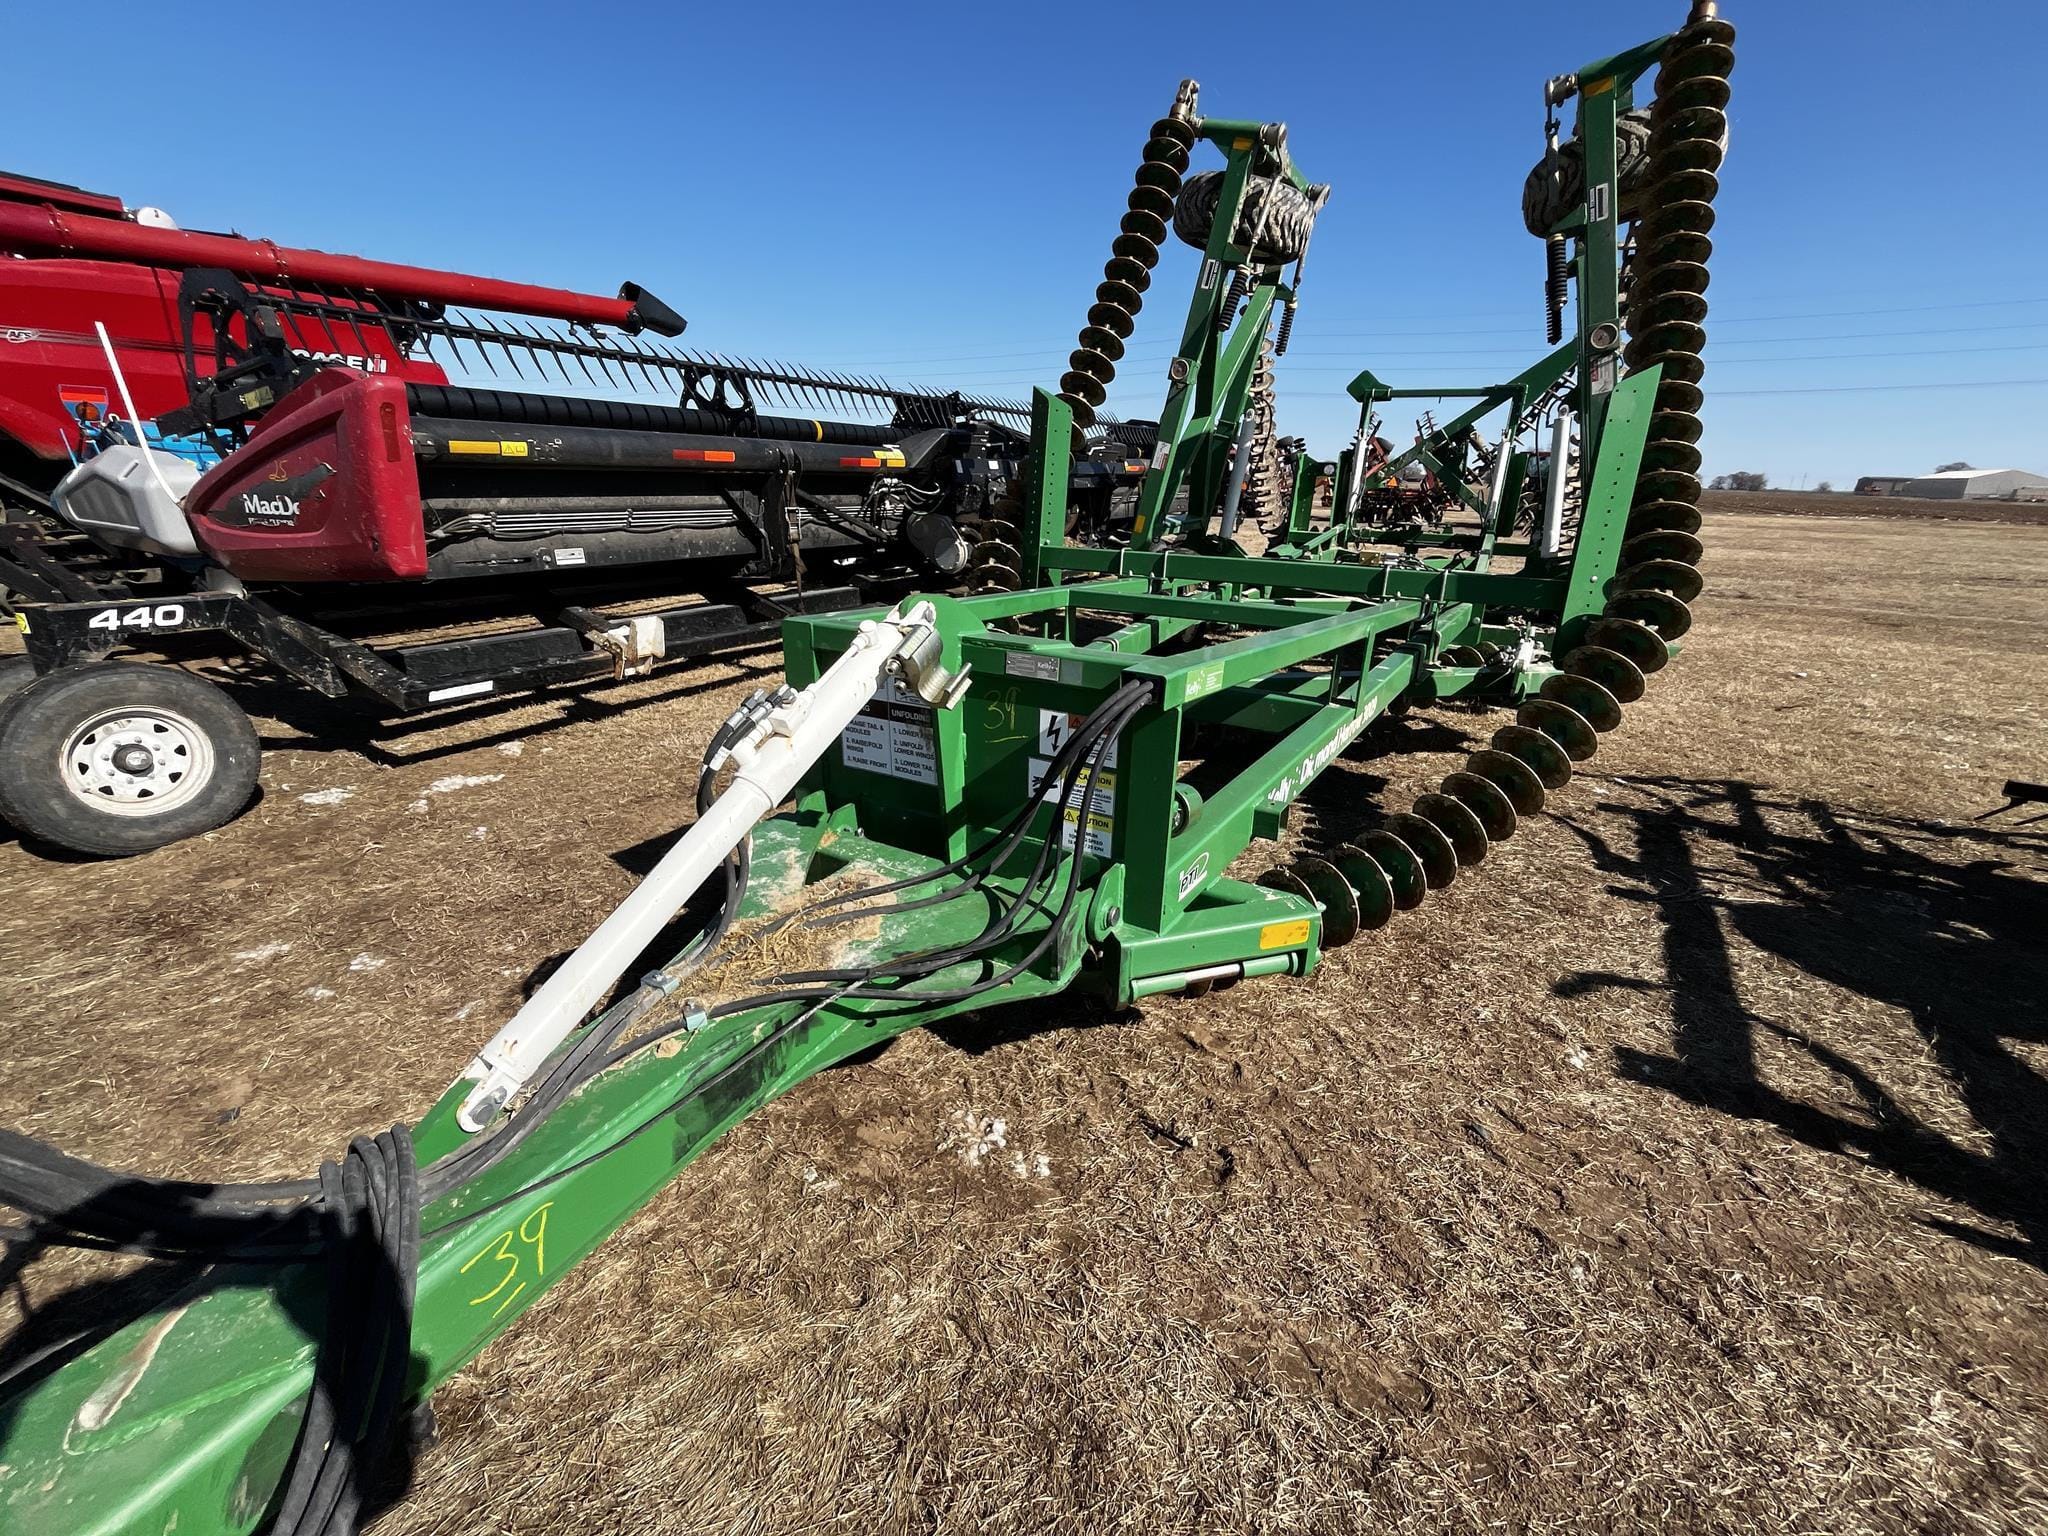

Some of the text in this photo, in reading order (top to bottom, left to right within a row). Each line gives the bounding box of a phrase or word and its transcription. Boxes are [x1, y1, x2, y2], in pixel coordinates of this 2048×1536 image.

[88, 604, 184, 631] 440
[983, 687, 1021, 732] 39
[845, 726, 871, 736] MODULES
[867, 722, 879, 731] TAIL
[846, 744, 864, 753] WINGS
[894, 747, 915, 756] LOWER
[852, 756, 868, 765] RAISE
[869, 758, 888, 769] FRONT
[900, 759, 921, 769] LOWER
[921, 764, 935, 772] TAIL
[894, 766, 922, 777] MODULES
[1179, 867, 1200, 894] PTI
[459, 1201, 555, 1307] 39
